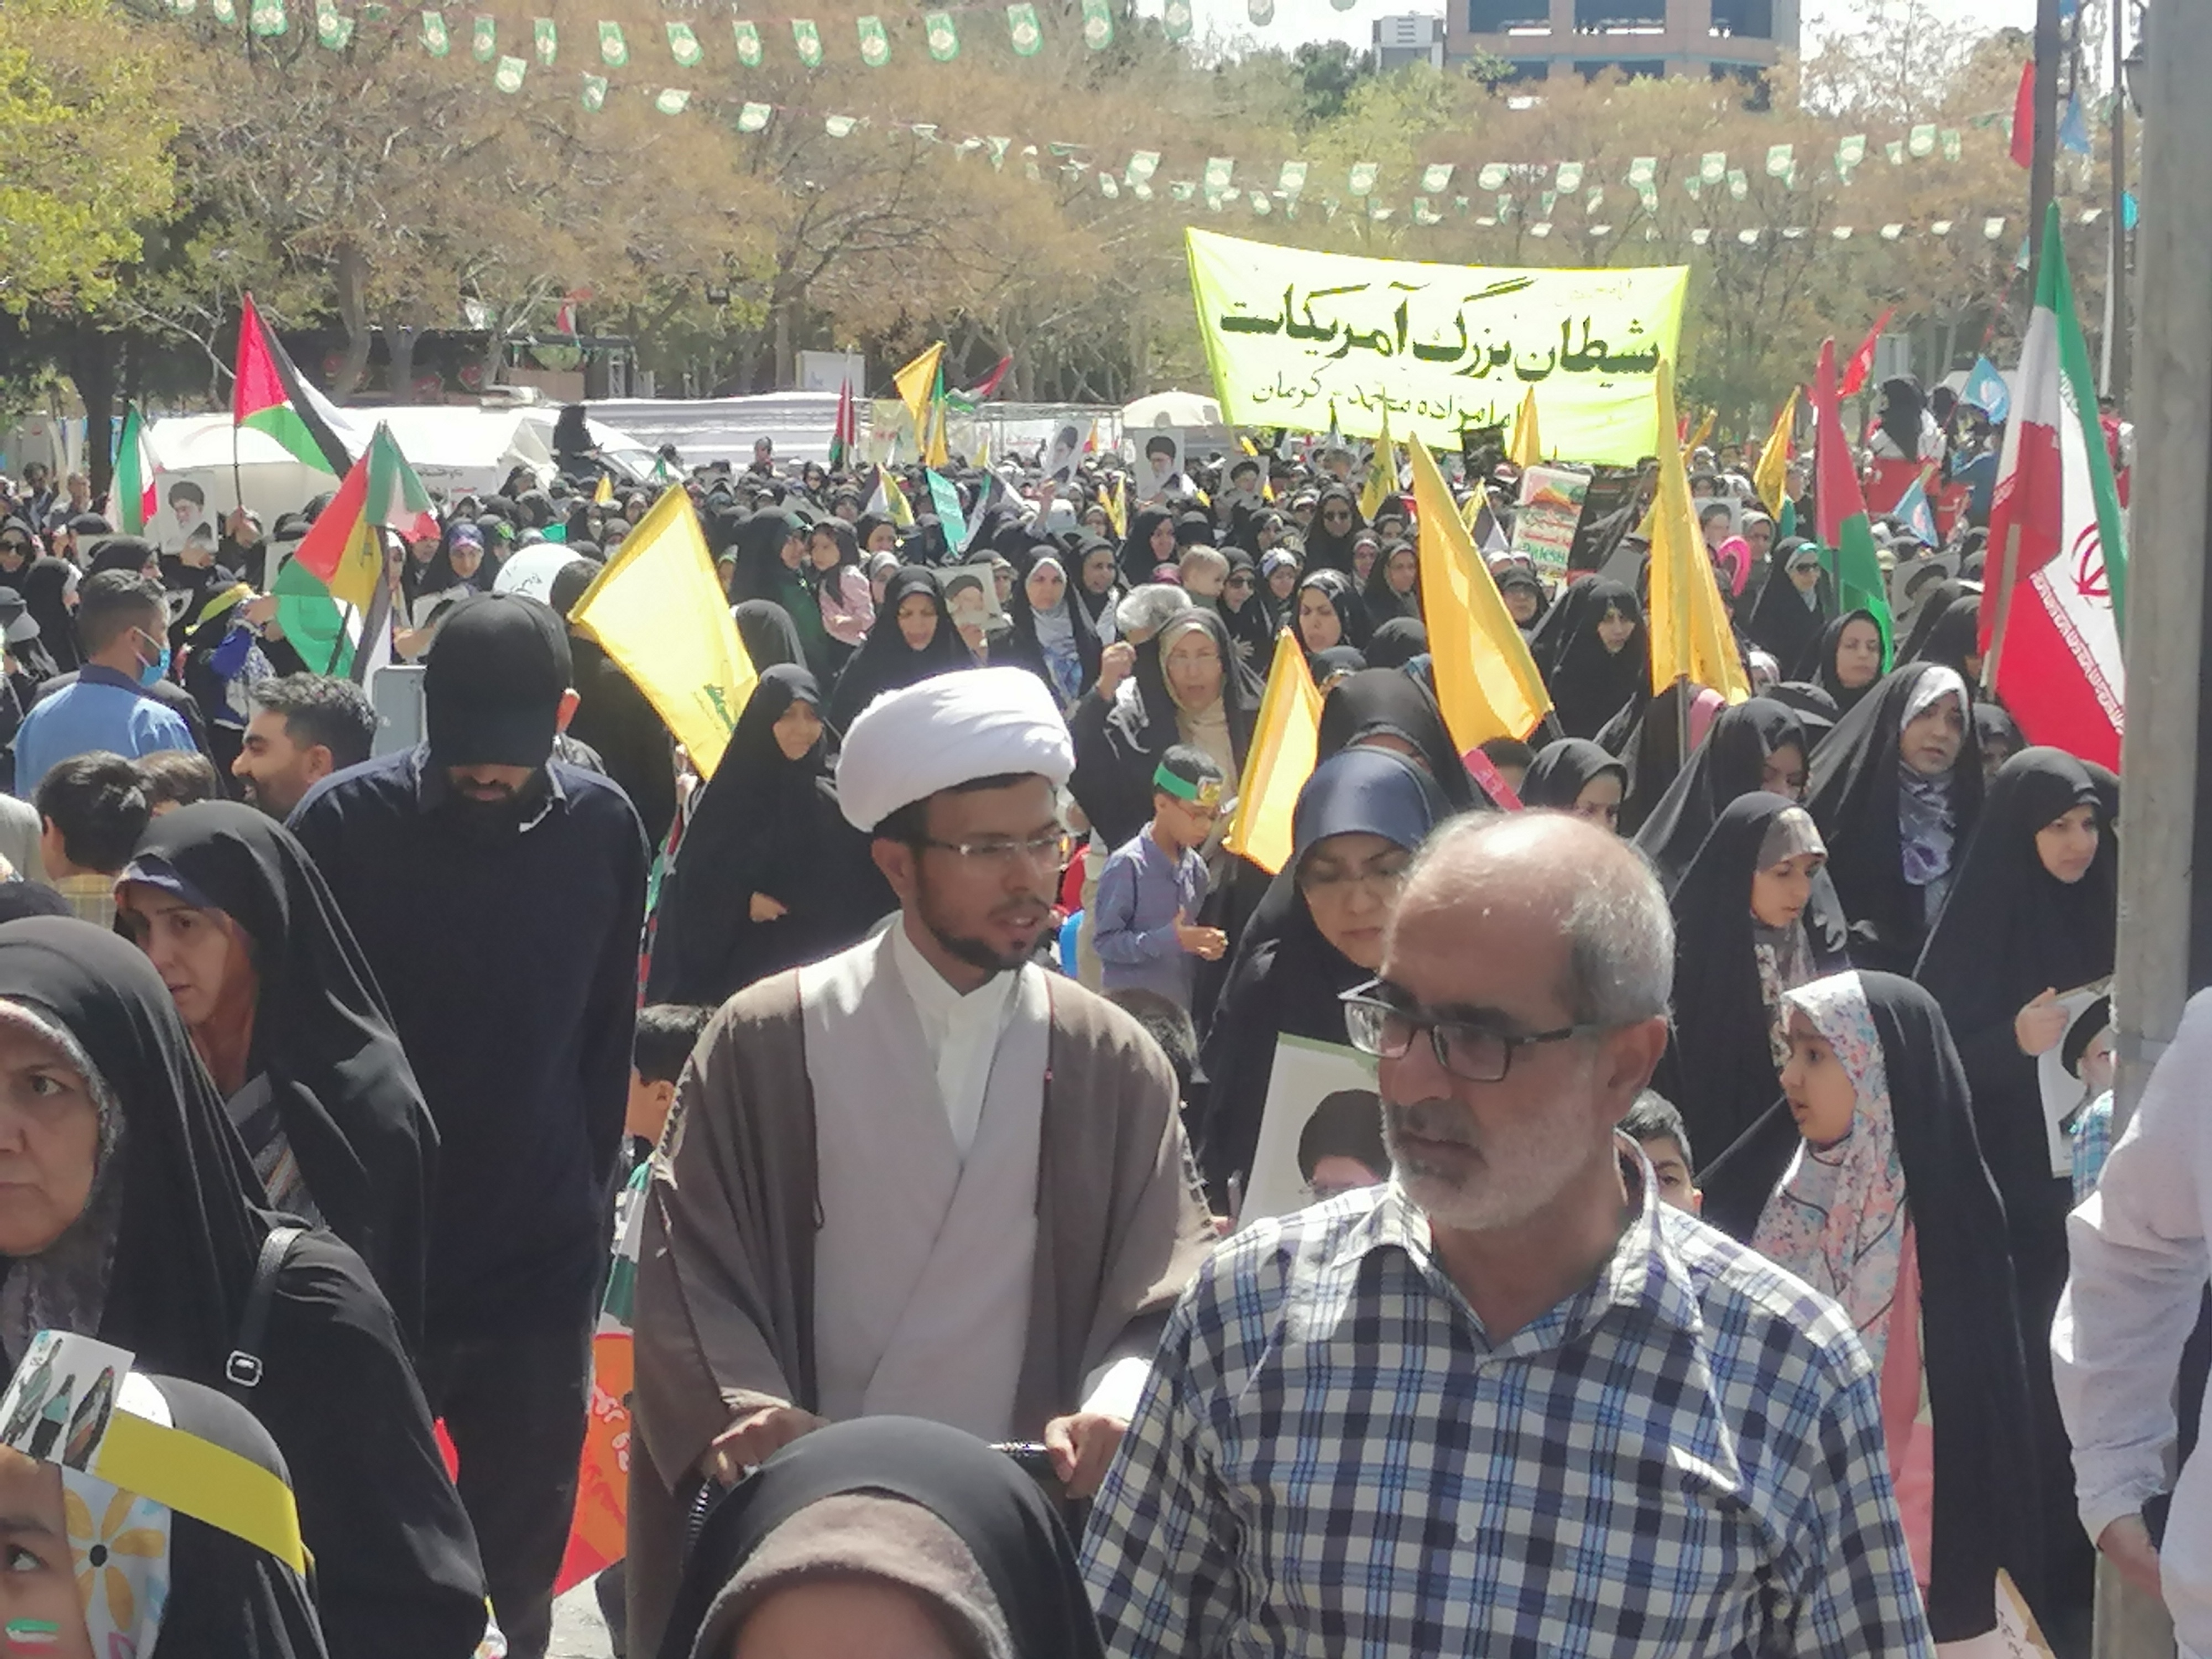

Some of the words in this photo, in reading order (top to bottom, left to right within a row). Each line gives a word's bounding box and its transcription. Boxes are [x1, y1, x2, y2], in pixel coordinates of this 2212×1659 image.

[1412, 276, 1538, 382] بزرگ
[1514, 315, 1660, 389] شیطان
[1253, 361, 1333, 409] کرمان
